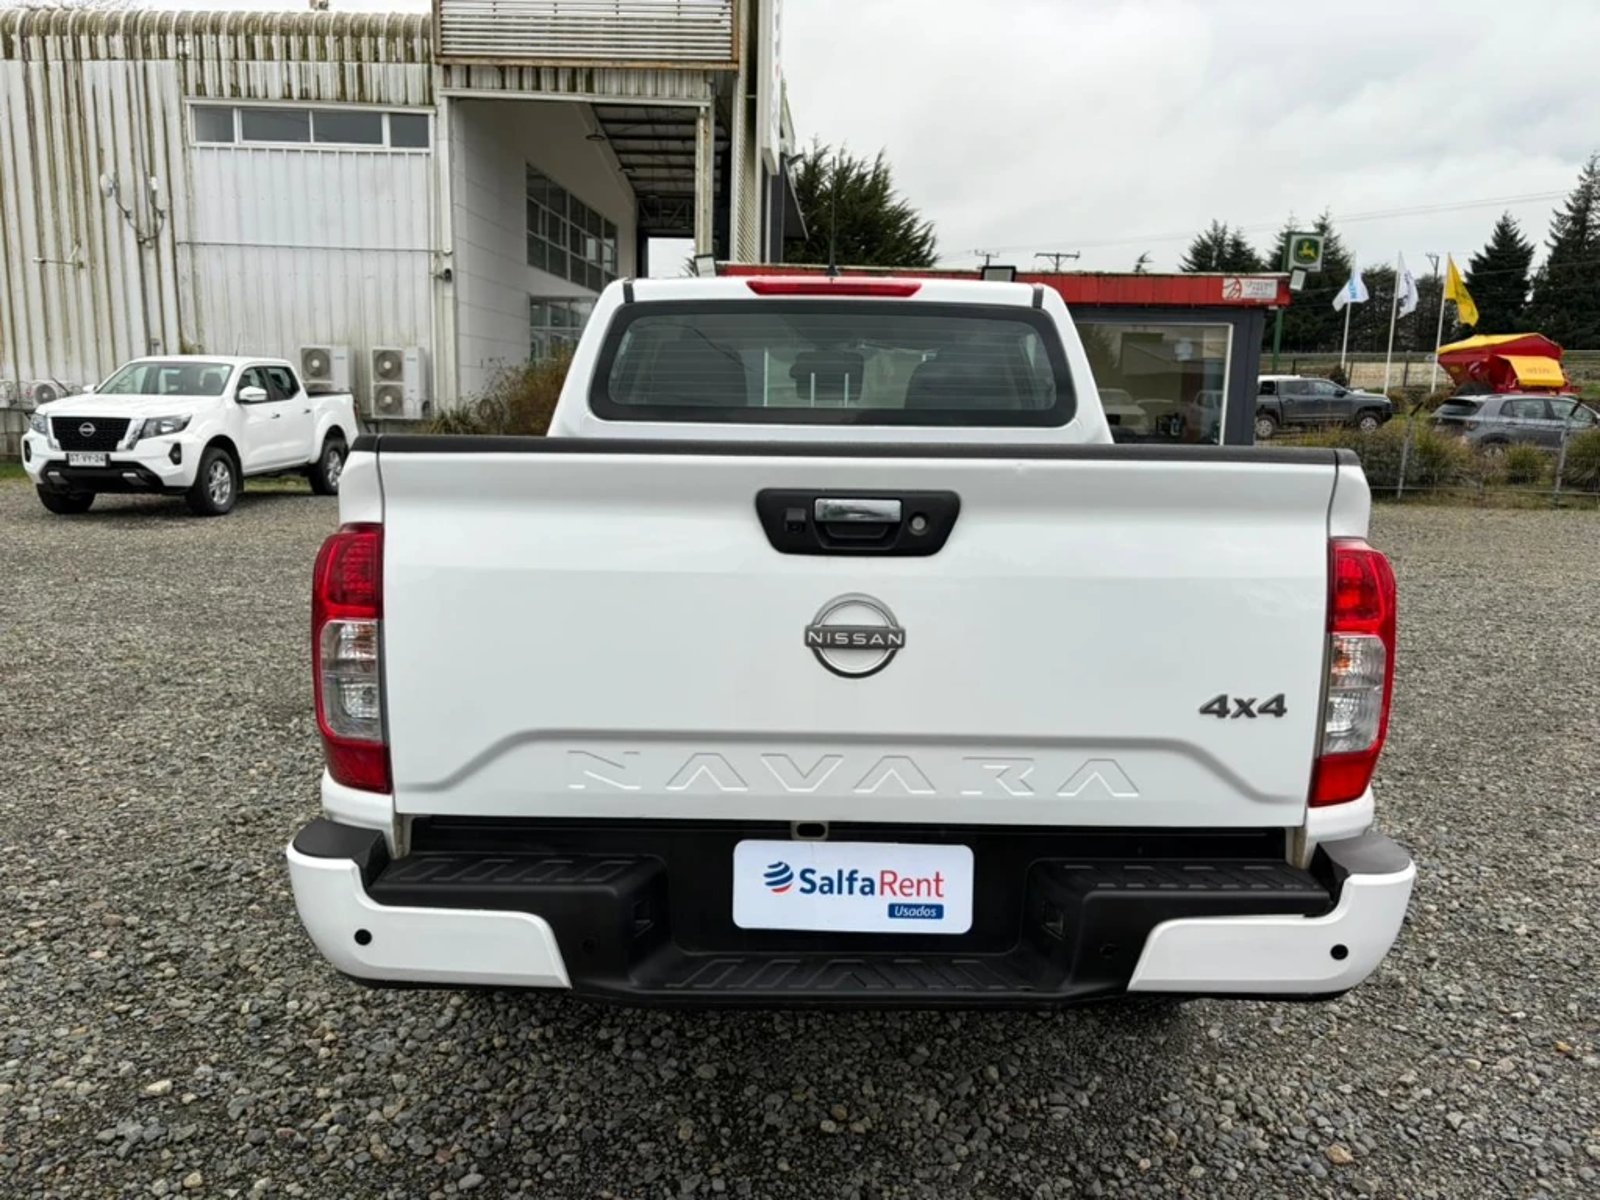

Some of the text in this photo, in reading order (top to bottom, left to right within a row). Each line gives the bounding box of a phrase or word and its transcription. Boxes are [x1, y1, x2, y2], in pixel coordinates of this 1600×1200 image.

[808, 631, 903, 645] NISSAN
[1198, 693, 1288, 719] 4x4
[566, 749, 1140, 798] NAVARA
[894, 905, 937, 918] Usados
